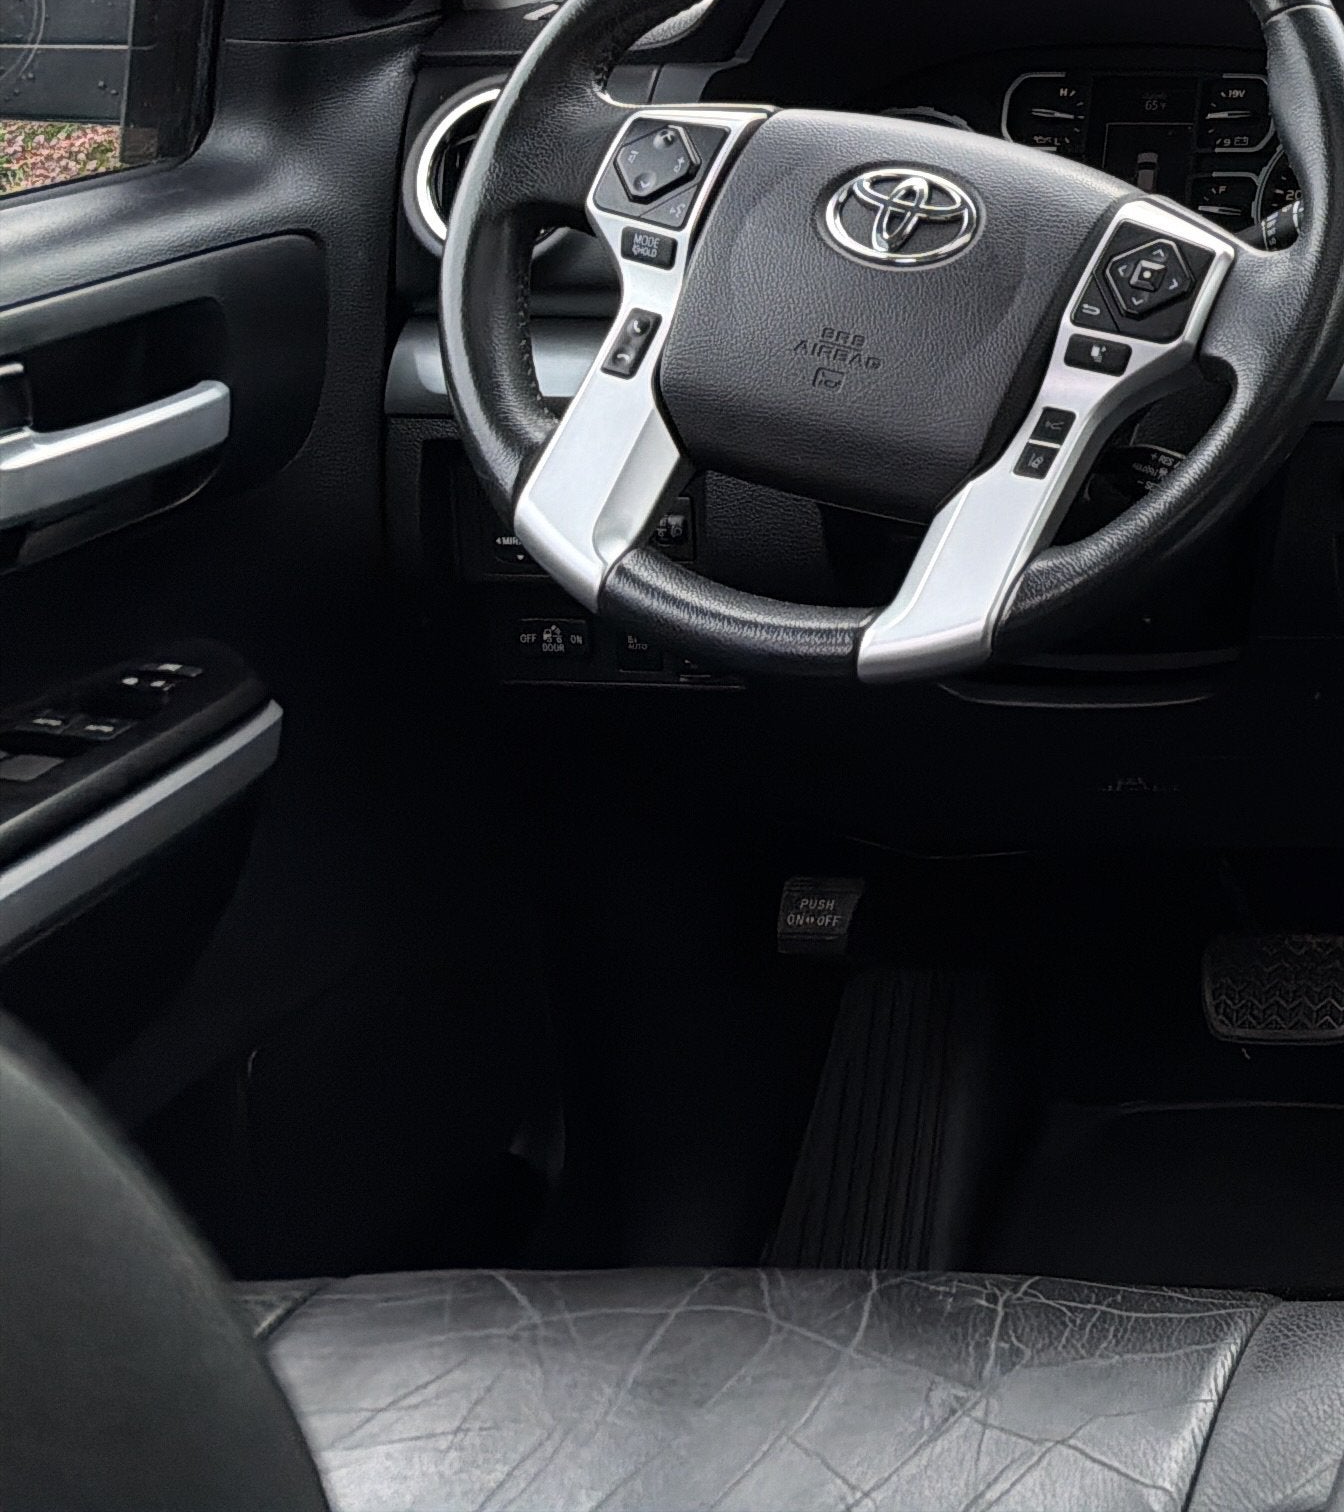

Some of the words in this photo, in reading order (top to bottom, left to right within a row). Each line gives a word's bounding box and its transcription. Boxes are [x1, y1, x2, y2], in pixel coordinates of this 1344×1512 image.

[633, 234, 661, 248] MODE
[794, 340, 881, 369] AIRBAG
[520, 633, 537, 644] OFF
[570, 634, 583, 645] ON
[542, 644, 565, 653] DOOR
[799, 898, 836, 911] PUSH
[786, 913, 805, 926] ON
[816, 914, 842, 927] OFF
